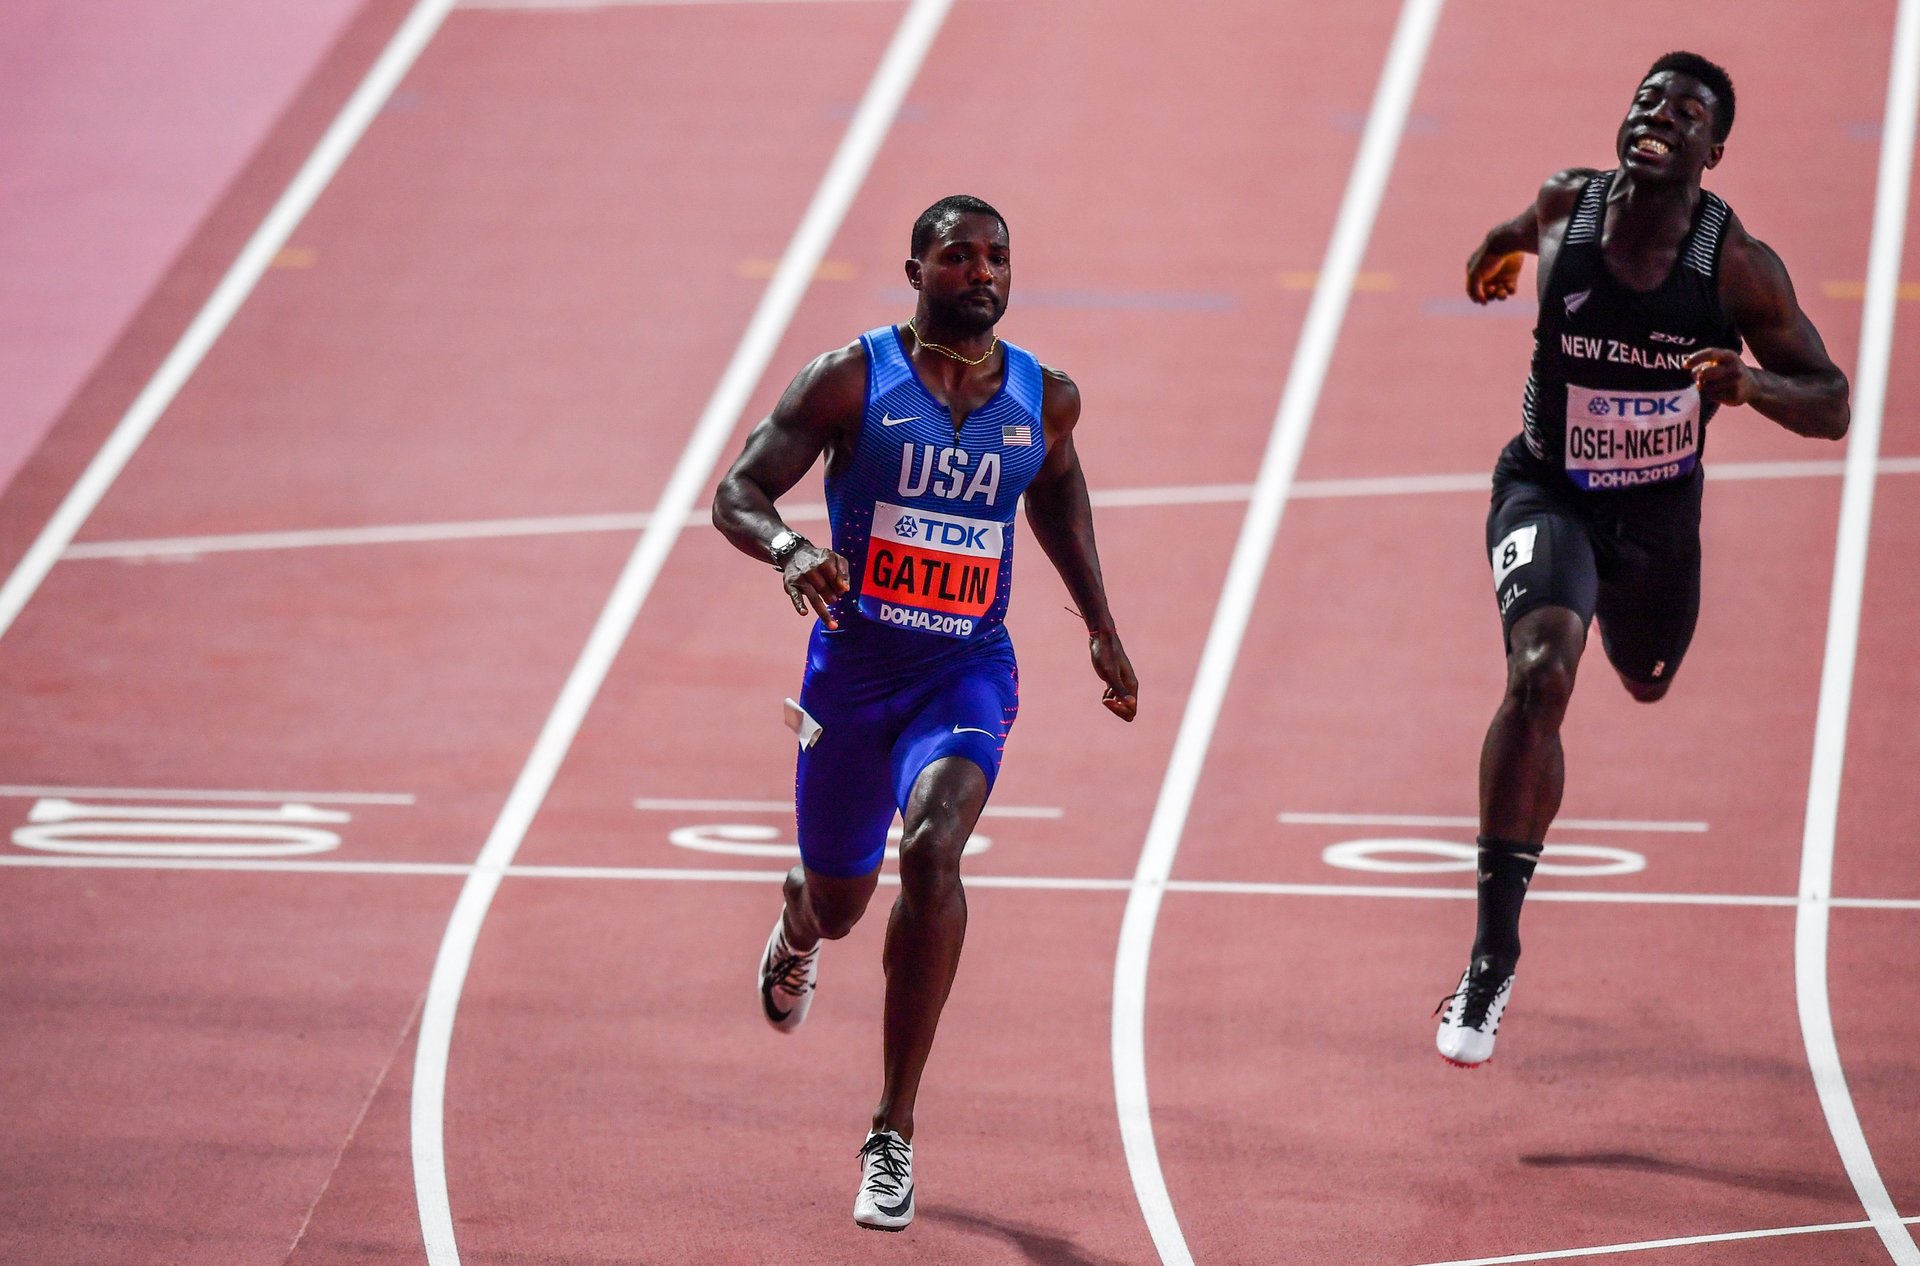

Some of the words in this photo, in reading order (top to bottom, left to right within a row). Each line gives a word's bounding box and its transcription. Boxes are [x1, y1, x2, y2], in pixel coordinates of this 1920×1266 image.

[1561, 333, 1602, 360] NEW
[1610, 396, 1681, 416] TDK
[1570, 420, 1693, 460] OSEI-NKETIA
[898, 443, 1000, 506] USA
[919, 518, 990, 550] TDK
[1502, 541, 1517, 570] 8
[872, 549, 991, 605] GATLIN
[11, 798, 352, 856] 10
[1322, 837, 1647, 876] 8
